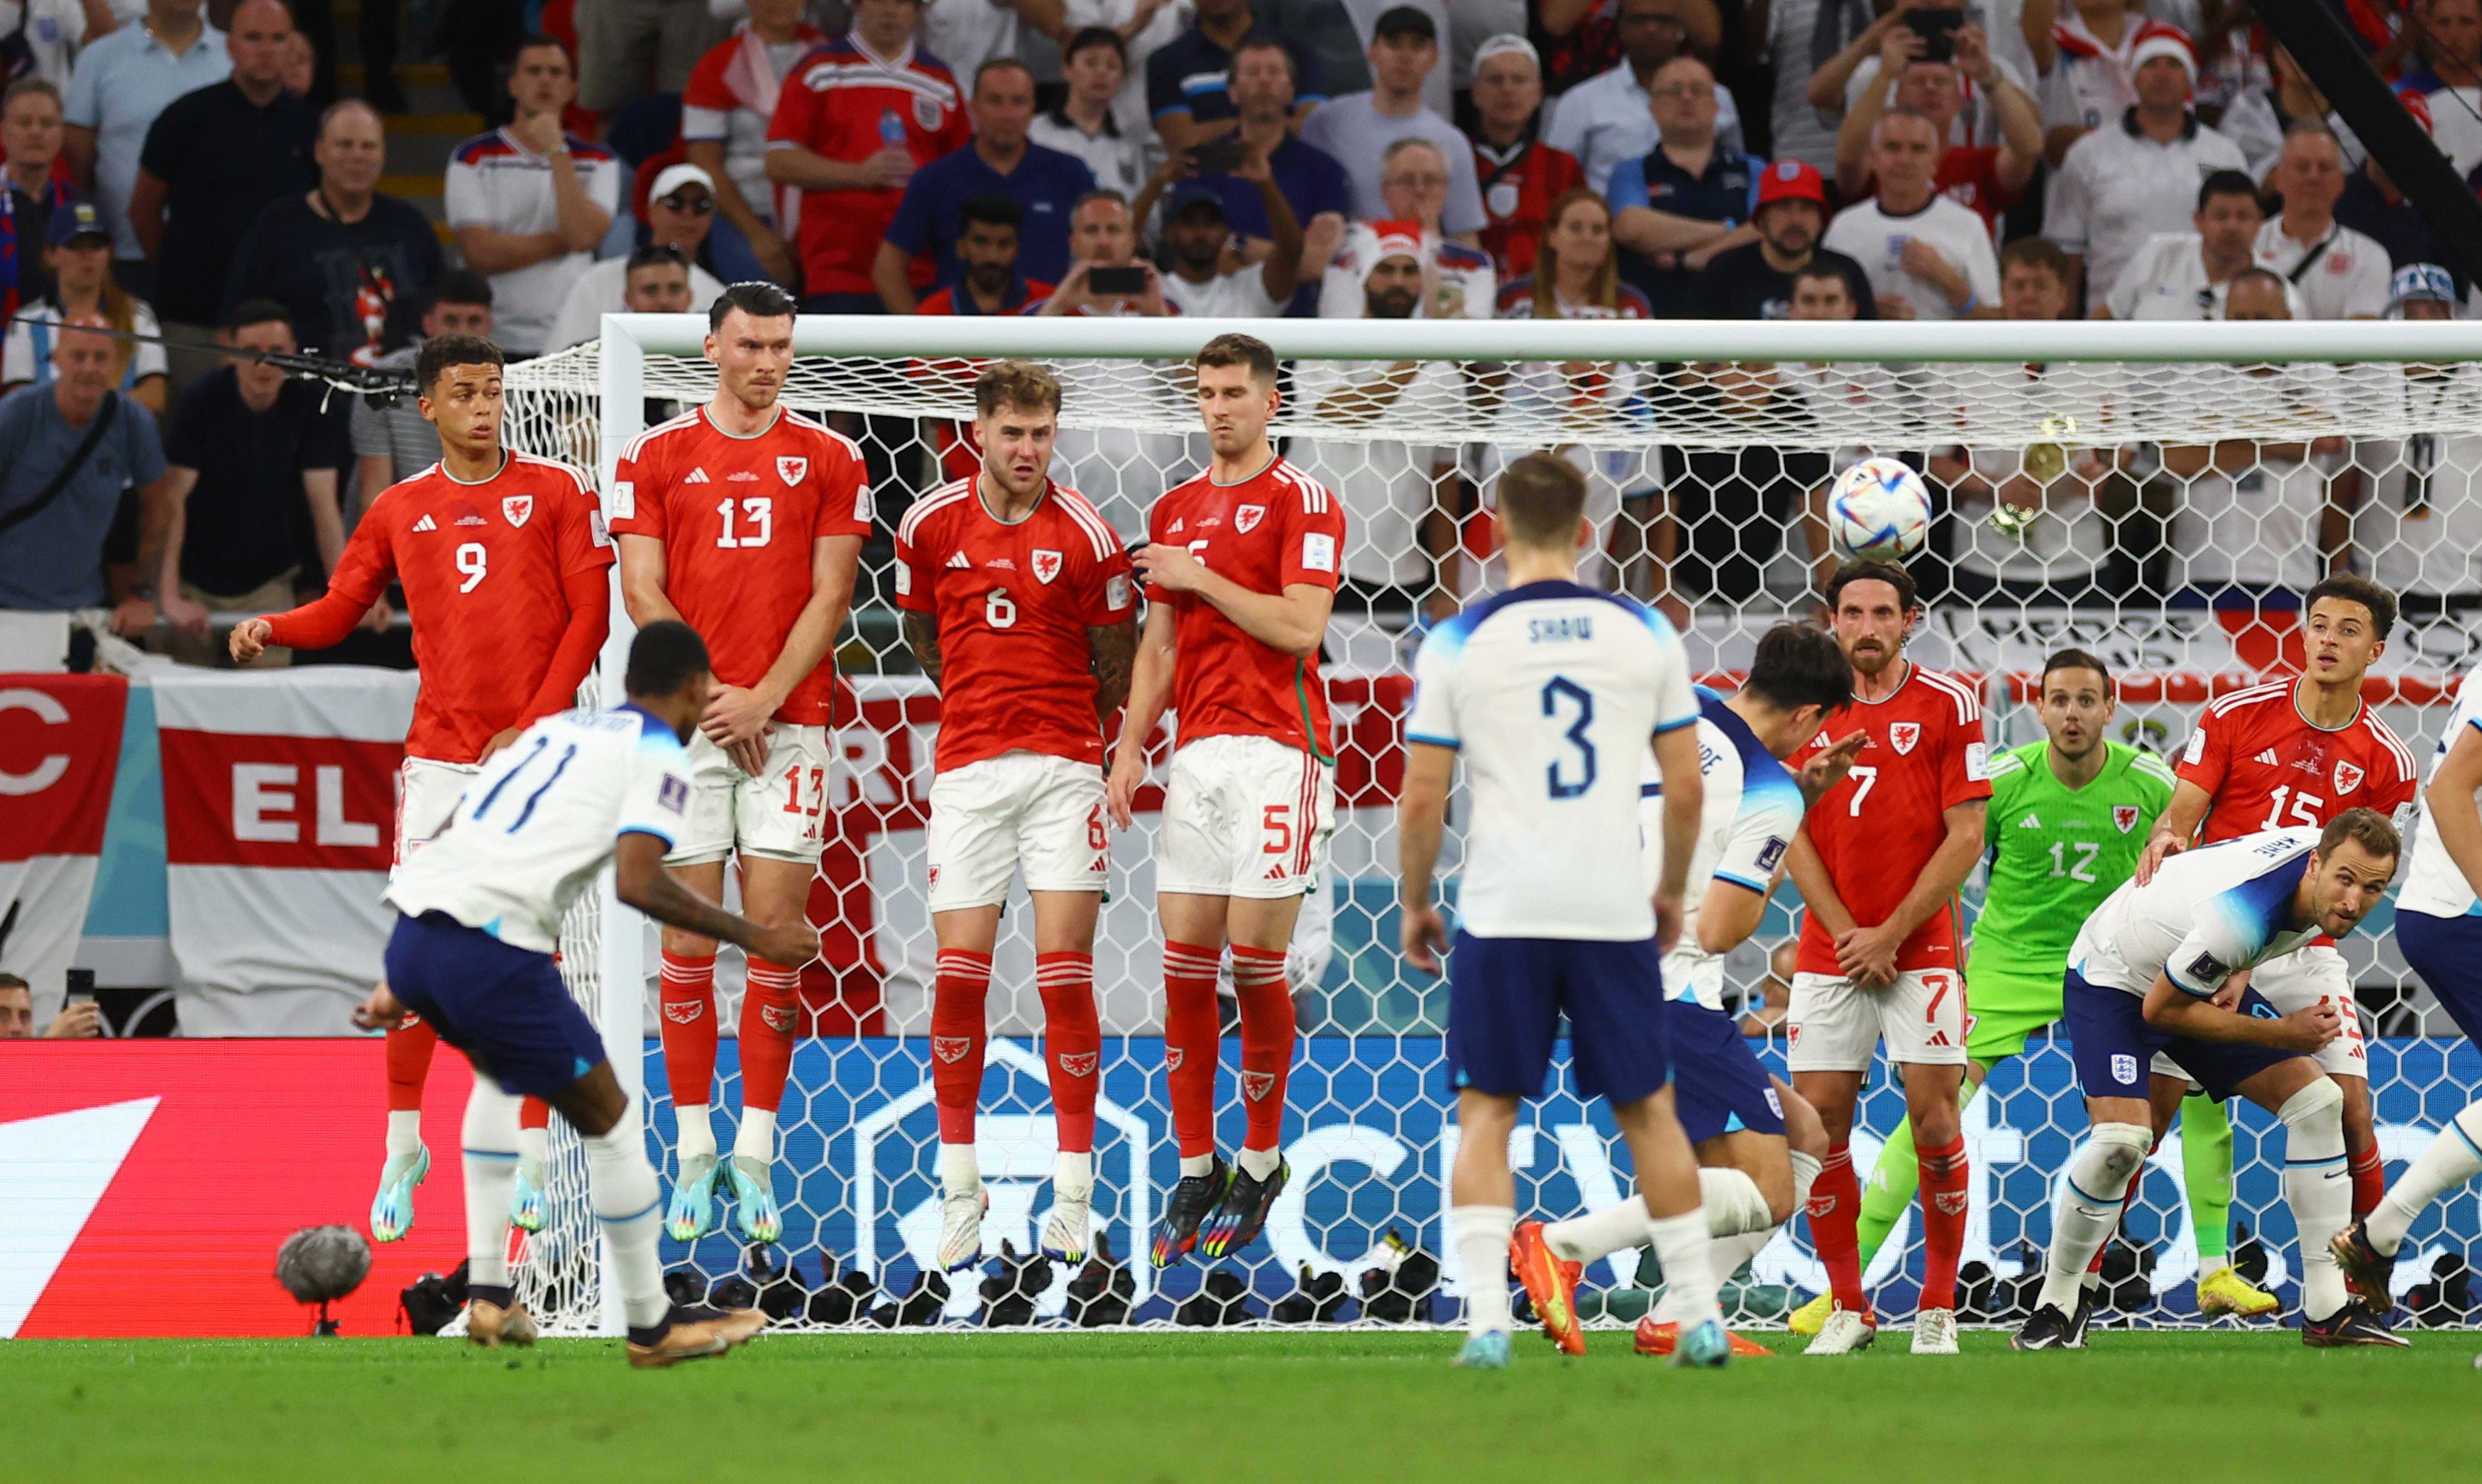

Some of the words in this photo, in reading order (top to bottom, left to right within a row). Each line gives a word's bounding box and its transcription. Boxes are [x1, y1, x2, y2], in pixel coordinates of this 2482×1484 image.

[716, 497, 772, 549] 13
[456, 542, 488, 593] 9
[985, 586, 1016, 628] 6
[1529, 617, 1593, 643] SHAW
[1541, 675, 1597, 801] 3
[231, 762, 399, 847] EL
[471, 735, 577, 835] 11
[783, 765, 824, 817] 13
[1847, 765, 1878, 818] 7
[2260, 784, 2324, 831] 15
[1087, 803, 1108, 850] 6
[1263, 805, 1291, 854] 5
[2048, 841, 2100, 884] 12
[1921, 974, 1950, 1024] 7
[2318, 994, 2363, 1041] 5
